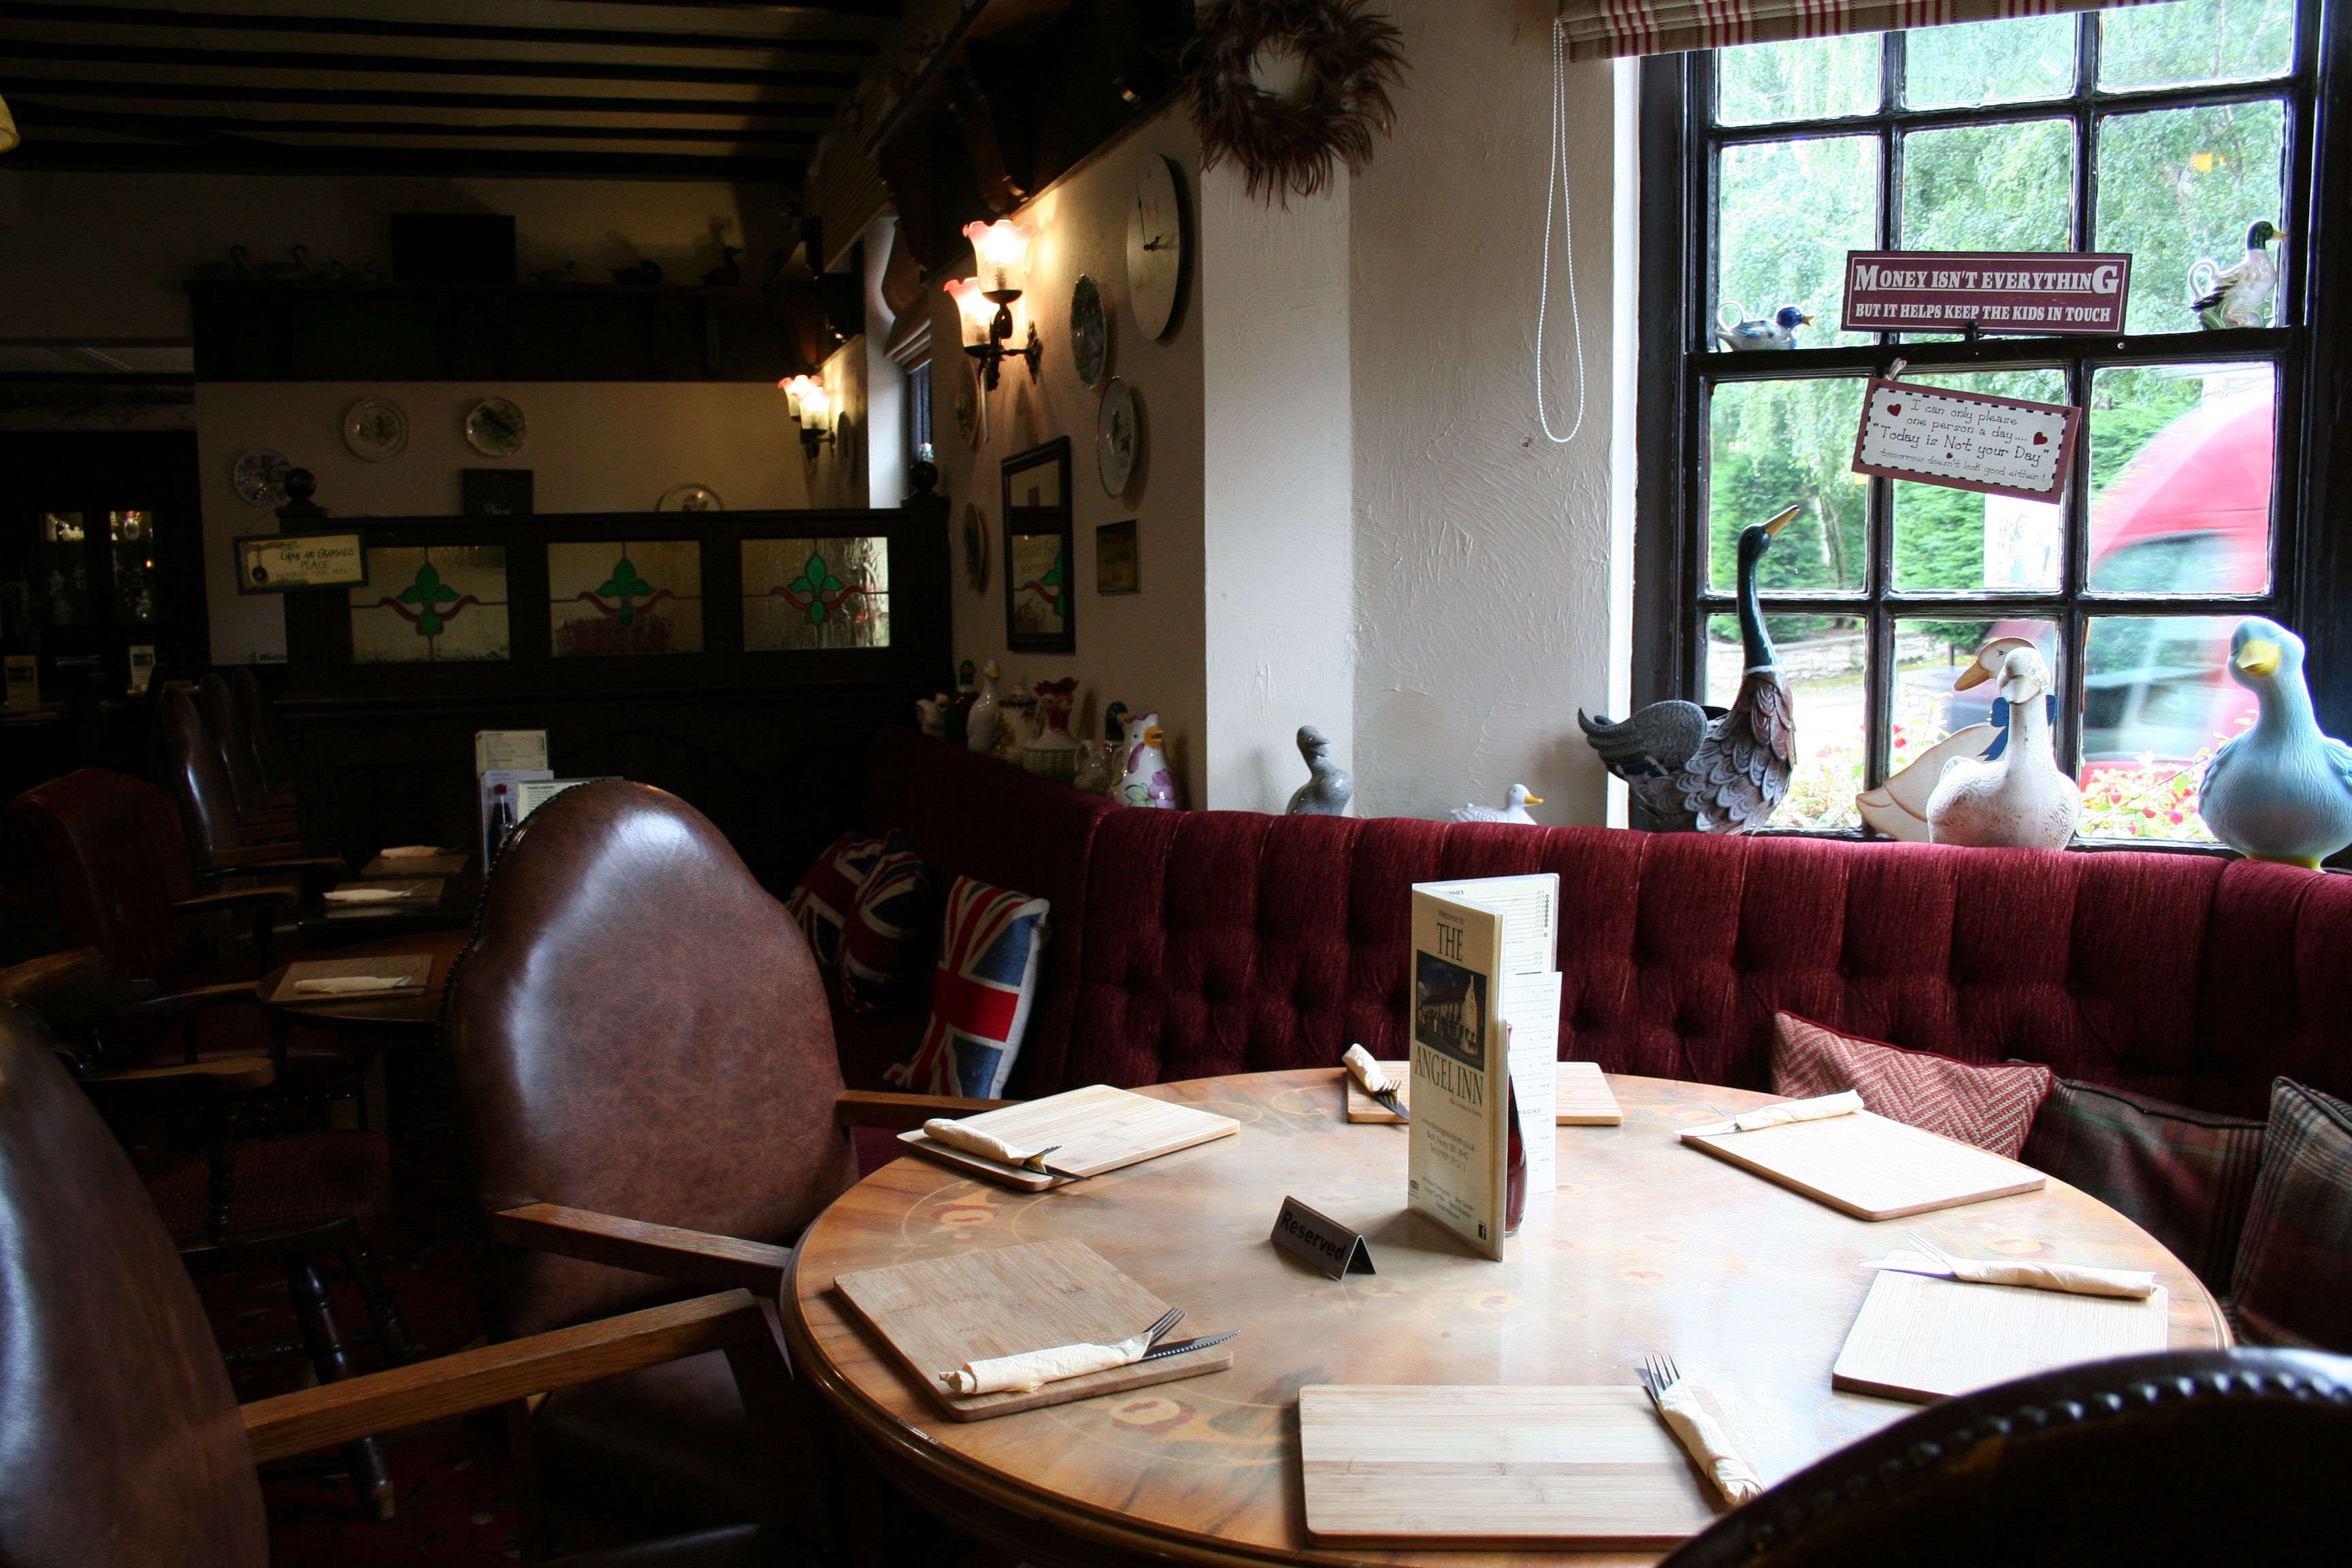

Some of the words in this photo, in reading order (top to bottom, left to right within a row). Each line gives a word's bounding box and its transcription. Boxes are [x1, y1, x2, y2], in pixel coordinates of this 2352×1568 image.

[1854, 265, 1928, 291] MONEY
[1931, 270, 1978, 289] ISN'T
[1980, 265, 2120, 294] EVERYTHING
[1855, 304, 1881, 317] BUT
[1882, 304, 1898, 318] IT
[1899, 304, 1942, 318] HELPS
[1944, 305, 1980, 319] KEEP
[1981, 306, 2010, 320] THE
[2012, 306, 2045, 321] KIDS
[2046, 307, 2063, 321] IN
[2065, 307, 2112, 322] TOUCH
[1906, 417, 1927, 427] one
[1931, 421, 1974, 435] person
[1910, 399, 1921, 410] I
[1925, 406, 1945, 415] can
[1950, 407, 1974, 424] only
[1977, 410, 2018, 425] please
[1926, 435, 1938, 446] is
[1944, 434, 1973, 451] Not
[1976, 446, 2009, 459] your
[1880, 448, 1925, 463] tomorrow
[1927, 455, 1961, 468] doesn't
[1963, 461, 1981, 472] look
[1984, 467, 2006, 476] good
[2008, 469, 2038, 480] either
[1437, 921, 1463, 961] THE
[1415, 1046, 1454, 1093] ANGEL
[1457, 1066, 1484, 1107] INN
[1280, 1210, 1347, 1263] Reserved
